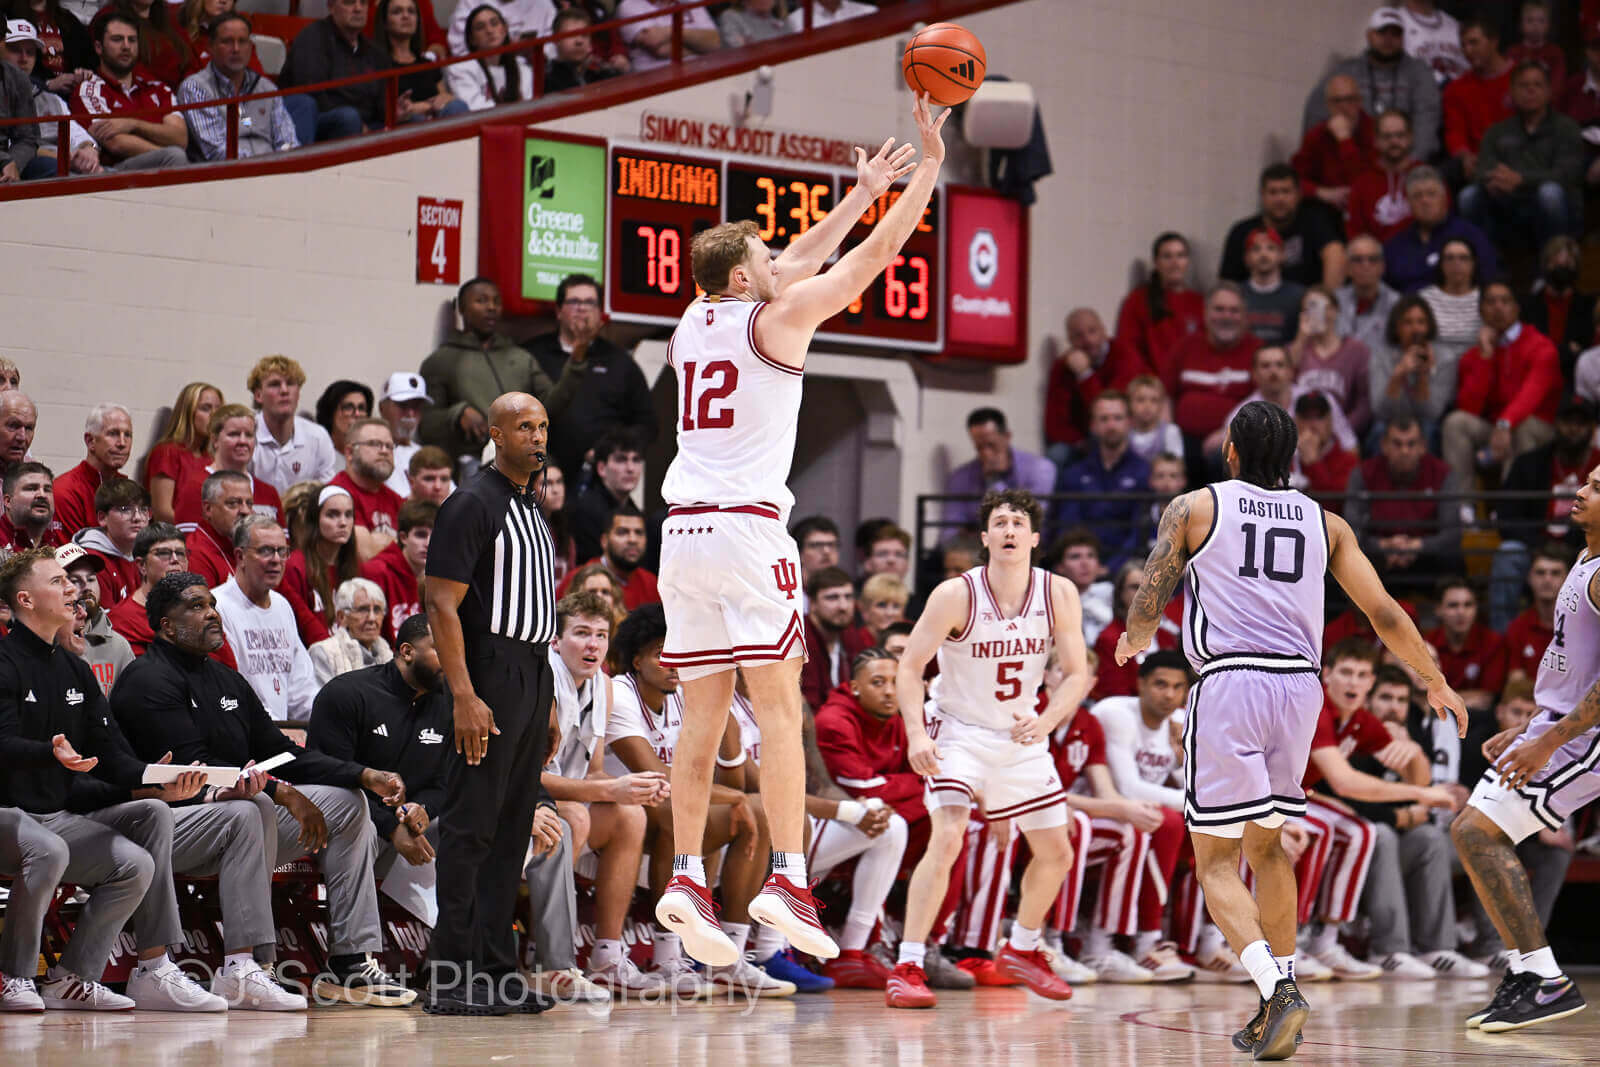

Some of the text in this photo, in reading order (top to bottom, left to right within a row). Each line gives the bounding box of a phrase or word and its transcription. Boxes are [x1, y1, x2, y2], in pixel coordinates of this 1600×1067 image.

[644, 114, 703, 146] SIMON
[777, 131, 864, 169] ASSEMBL
[617, 156, 718, 207] INDIANA
[420, 204, 460, 228] SECTION
[527, 201, 585, 233] Greene
[430, 228, 447, 275] 4
[637, 226, 680, 294] 78
[885, 254, 929, 320] 63
[682, 359, 739, 431] 12
[1238, 497, 1304, 521] CASTILLO
[1238, 522, 1306, 583] 10
[970, 638, 1046, 658] INDIANA
[994, 660, 1025, 702] 5
